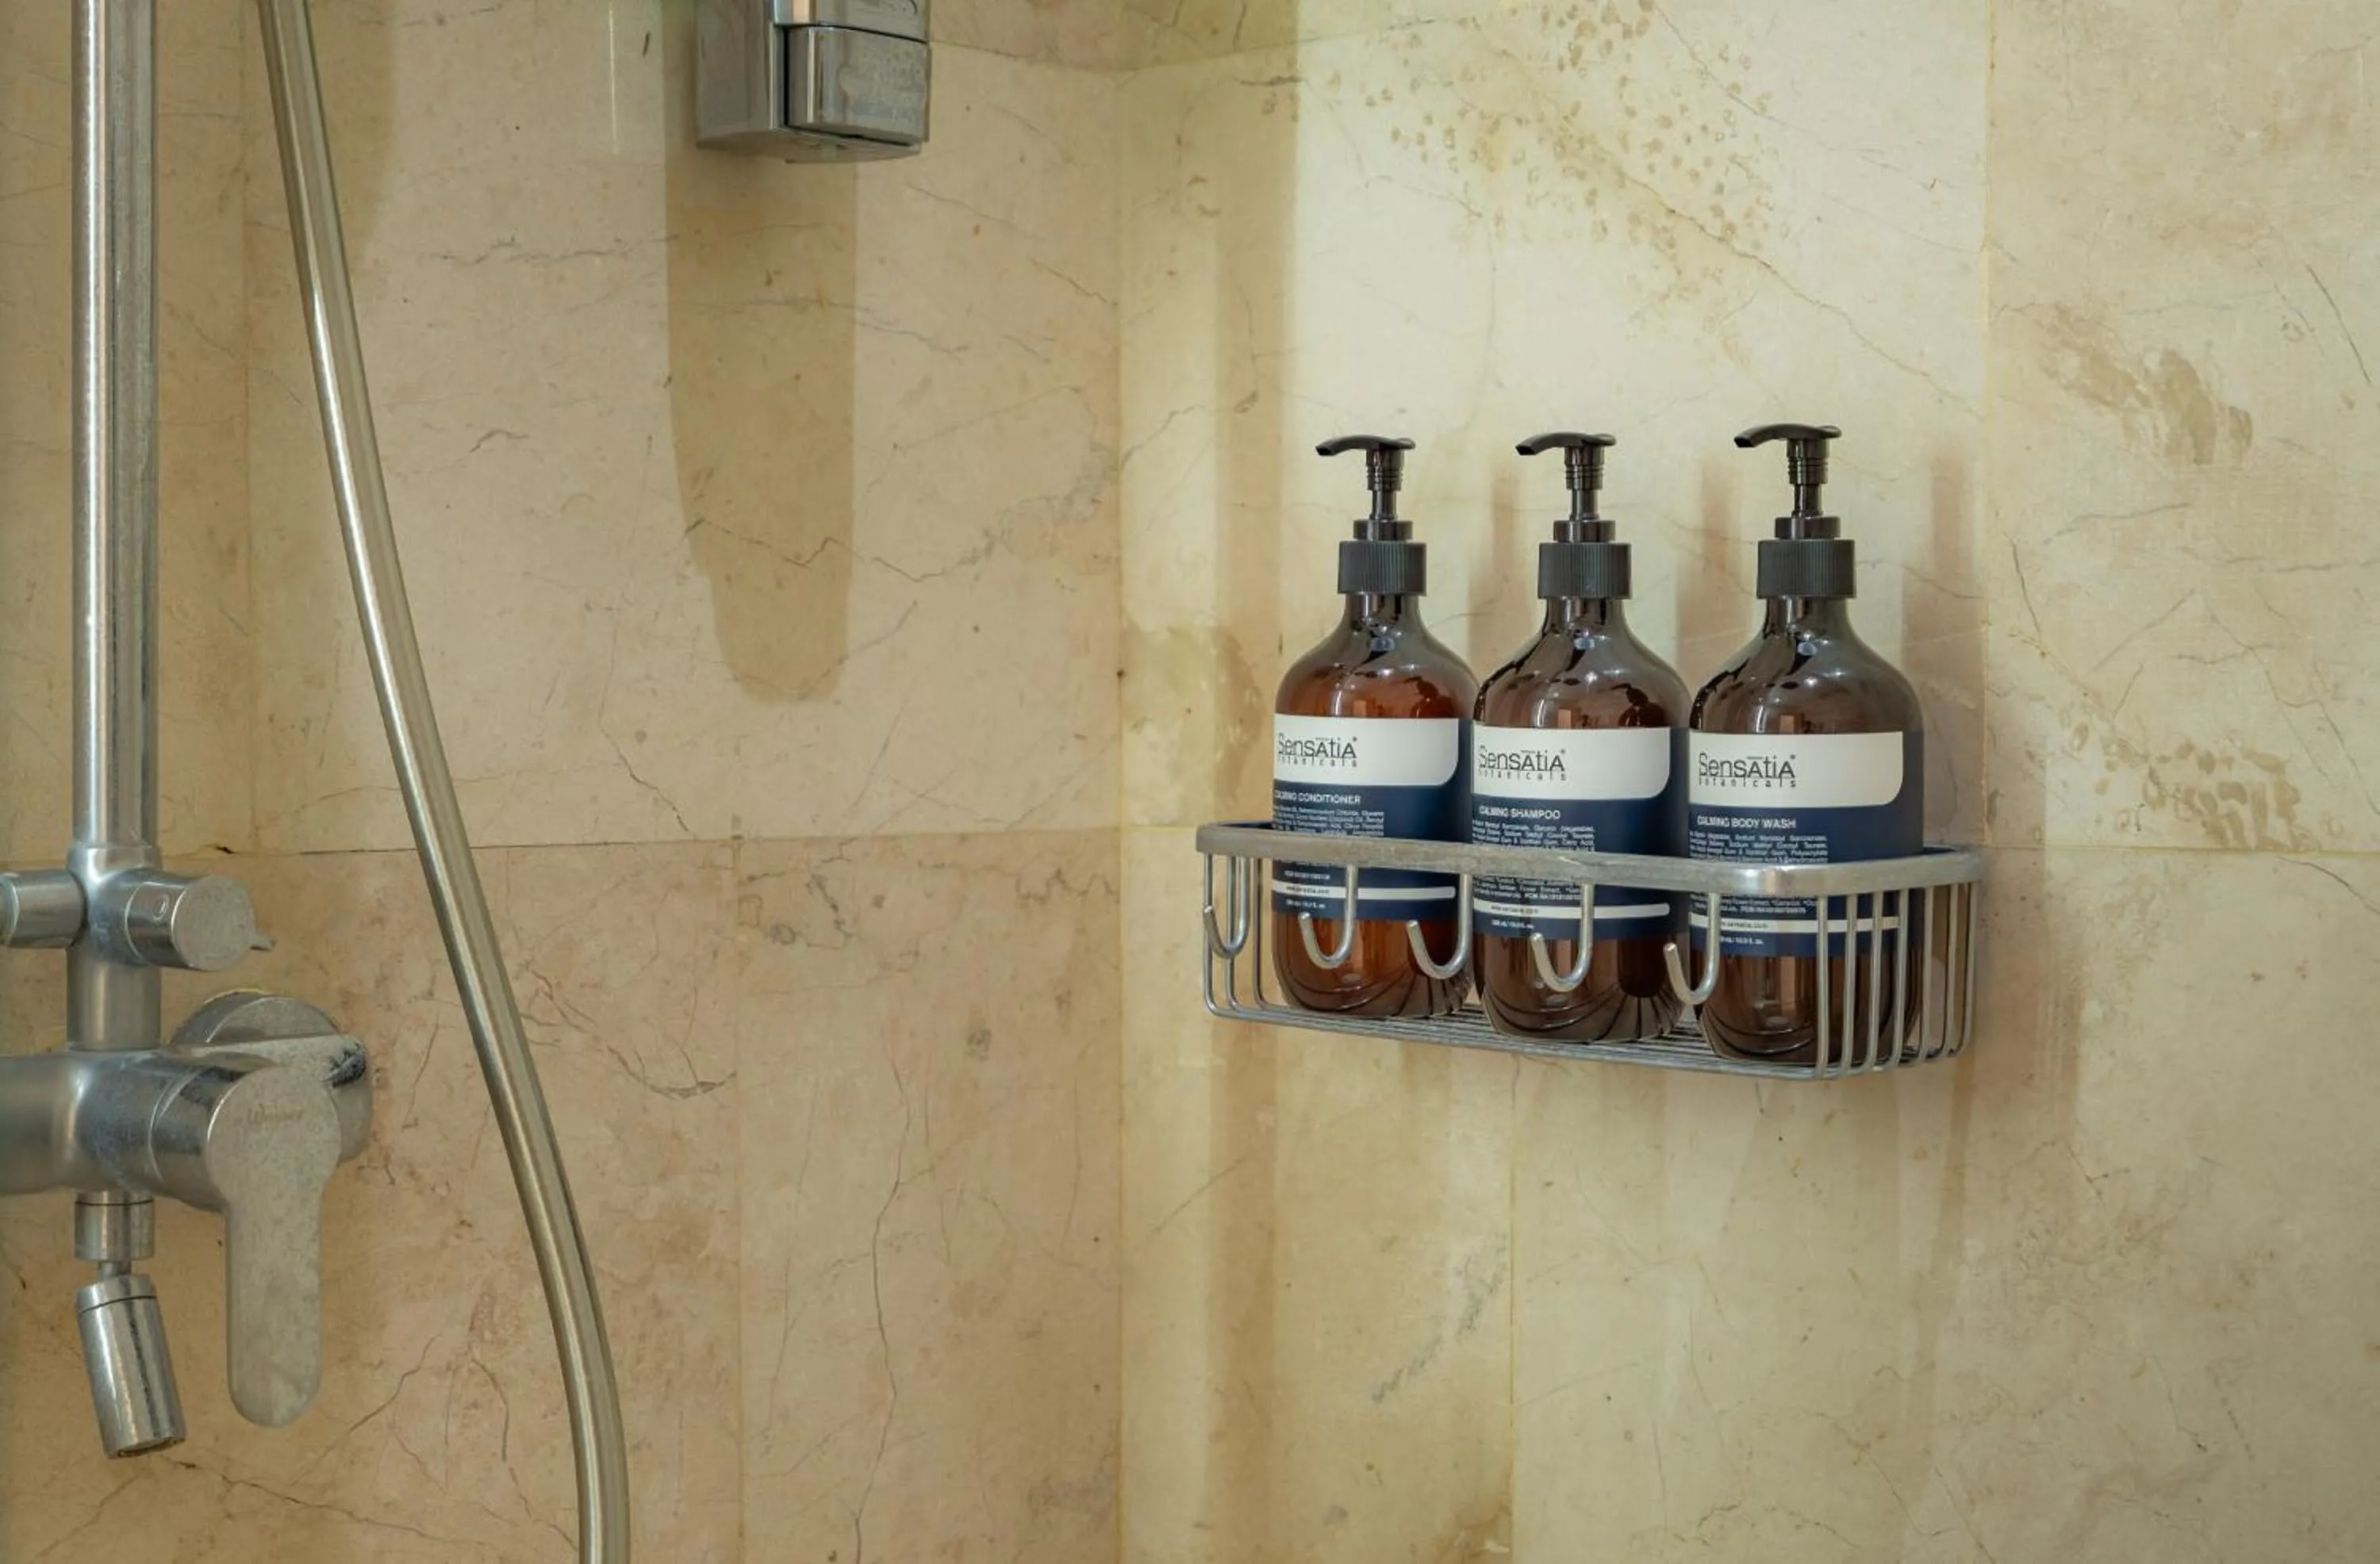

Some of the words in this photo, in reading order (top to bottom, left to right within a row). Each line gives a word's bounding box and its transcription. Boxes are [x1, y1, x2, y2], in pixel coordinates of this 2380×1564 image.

[1298, 792, 1361, 805] CONDITIONER
[1510, 807, 1561, 820] SHAMPOO
[1731, 817, 1760, 829] BODY
[1760, 818, 1797, 829] WASH
